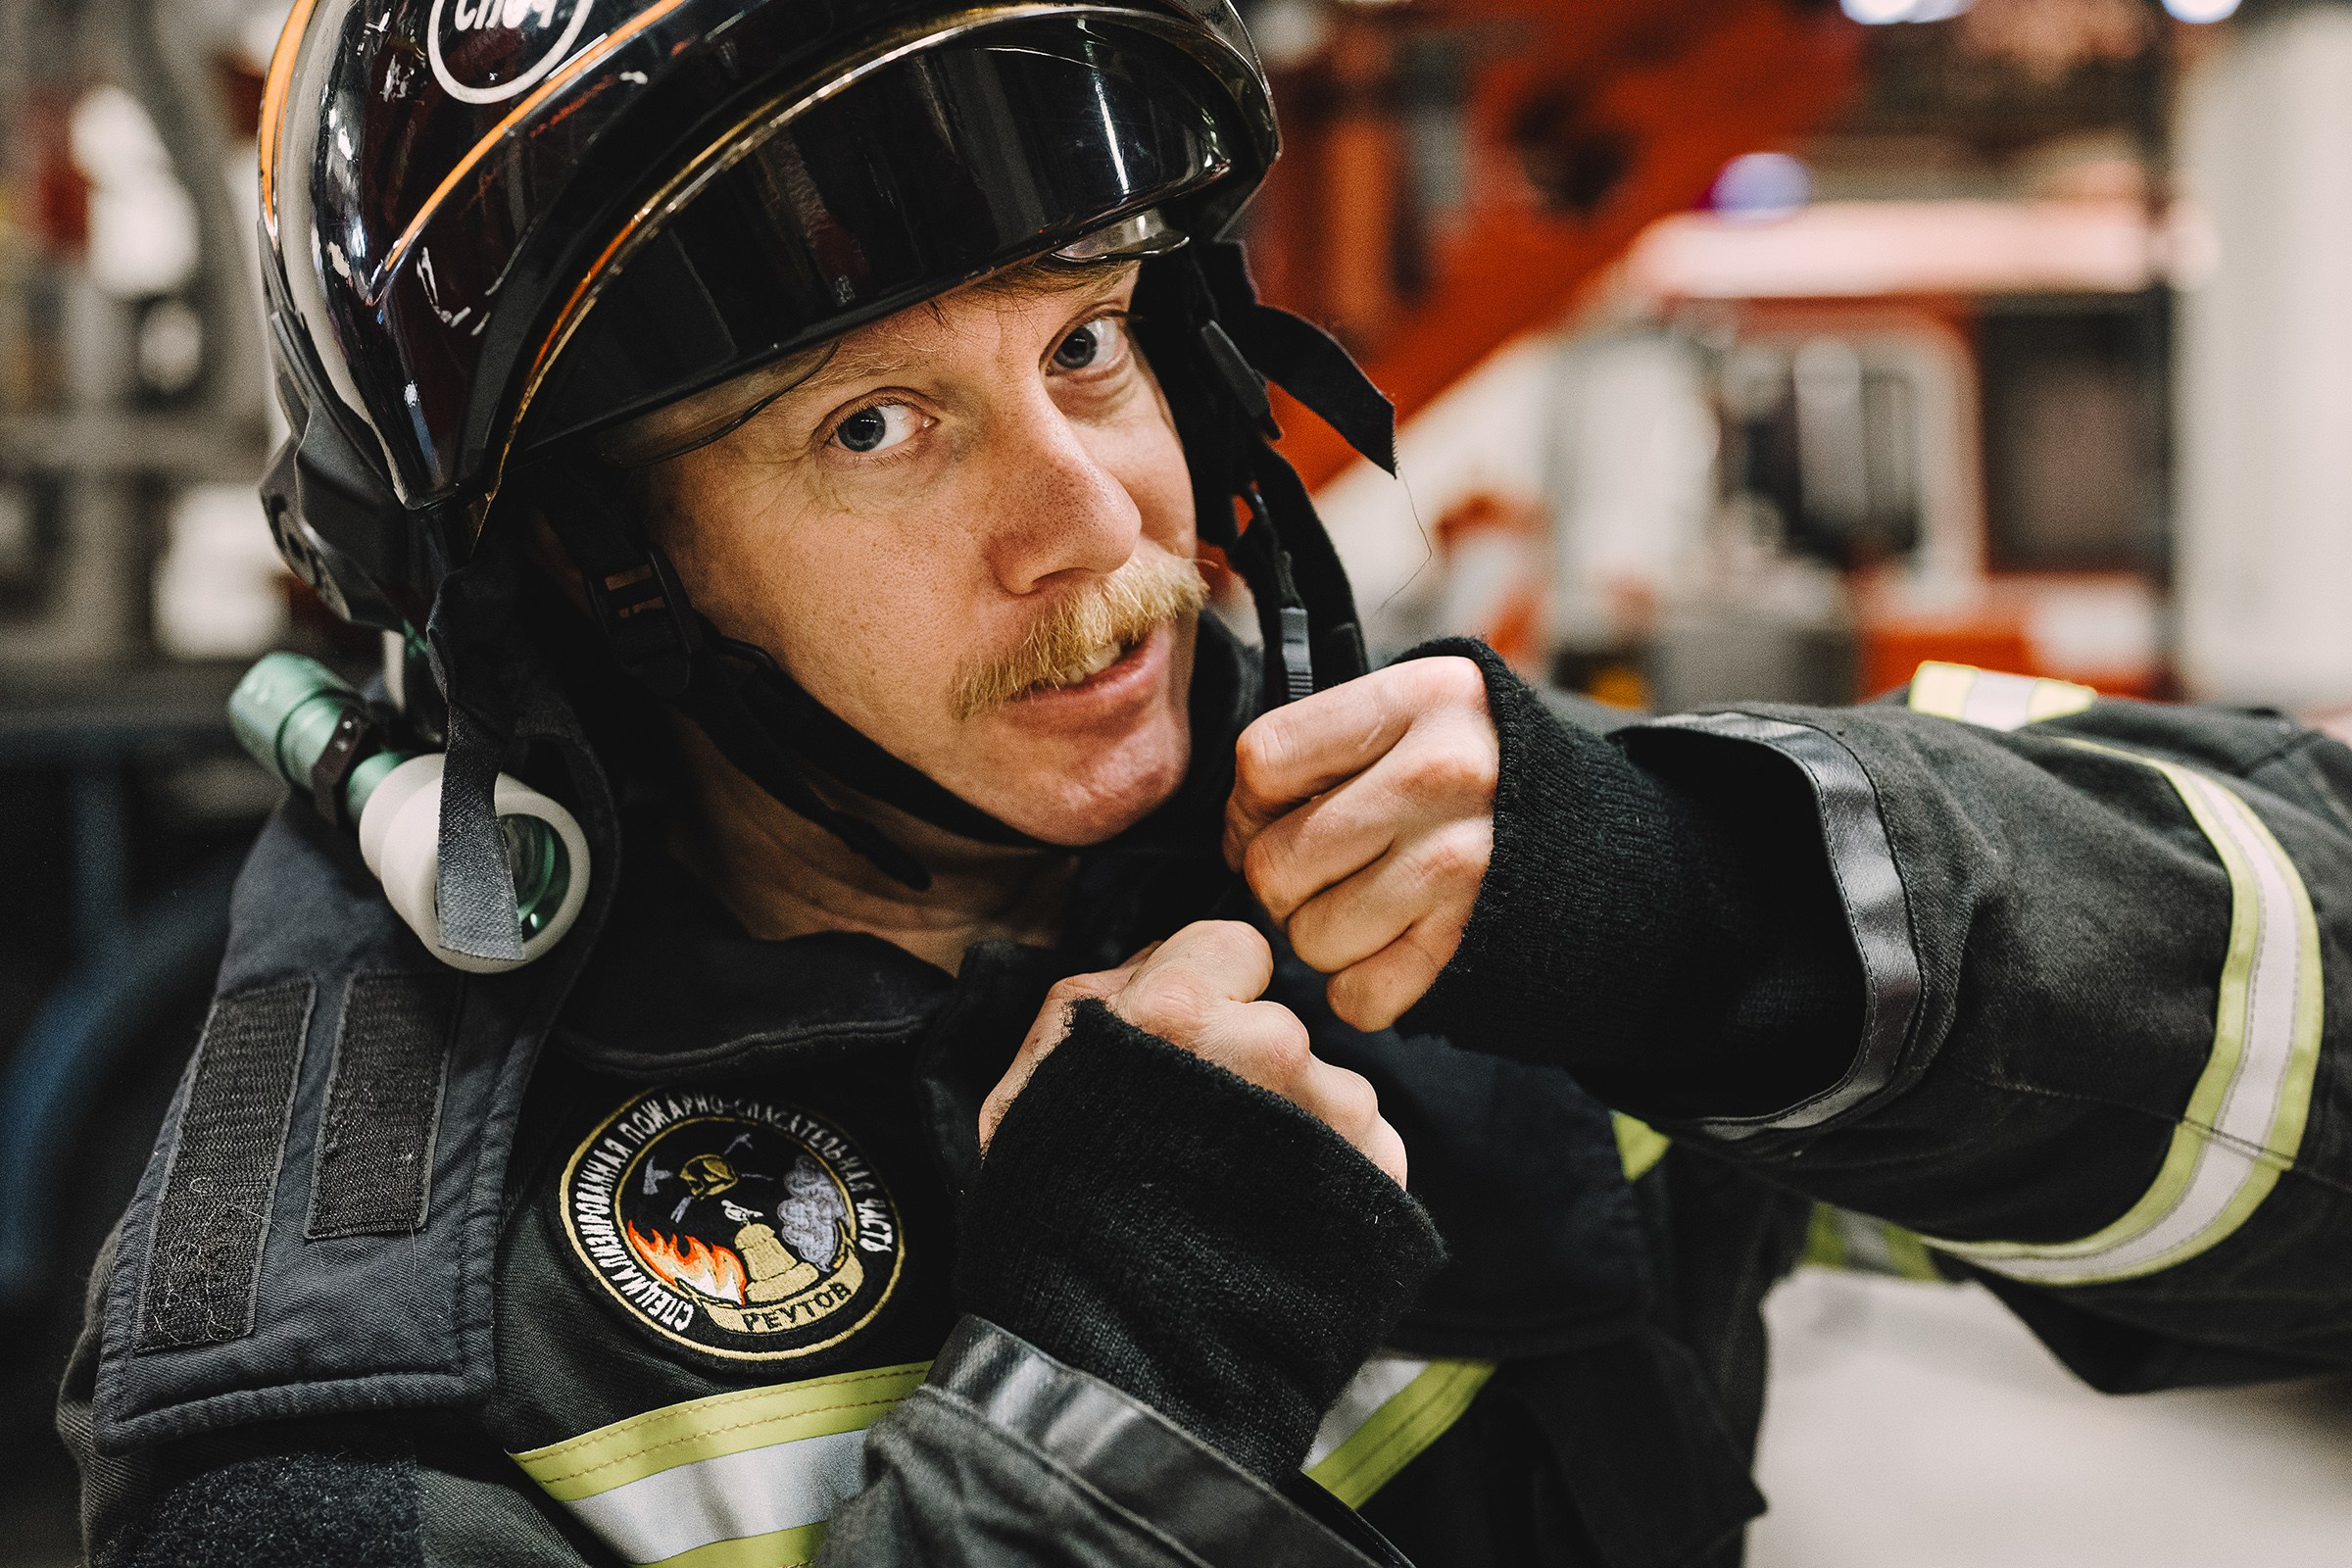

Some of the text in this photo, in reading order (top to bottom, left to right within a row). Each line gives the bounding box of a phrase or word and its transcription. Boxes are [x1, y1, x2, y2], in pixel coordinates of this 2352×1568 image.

[575, 1093, 893, 1332] СПЕЦИАЛИЗИРОВАННАЯ ПОЖАРНО-СПАСАТЕЛЬНАЯ ЧАСТЬ
[741, 1282, 853, 1333] РЕУТОВ
